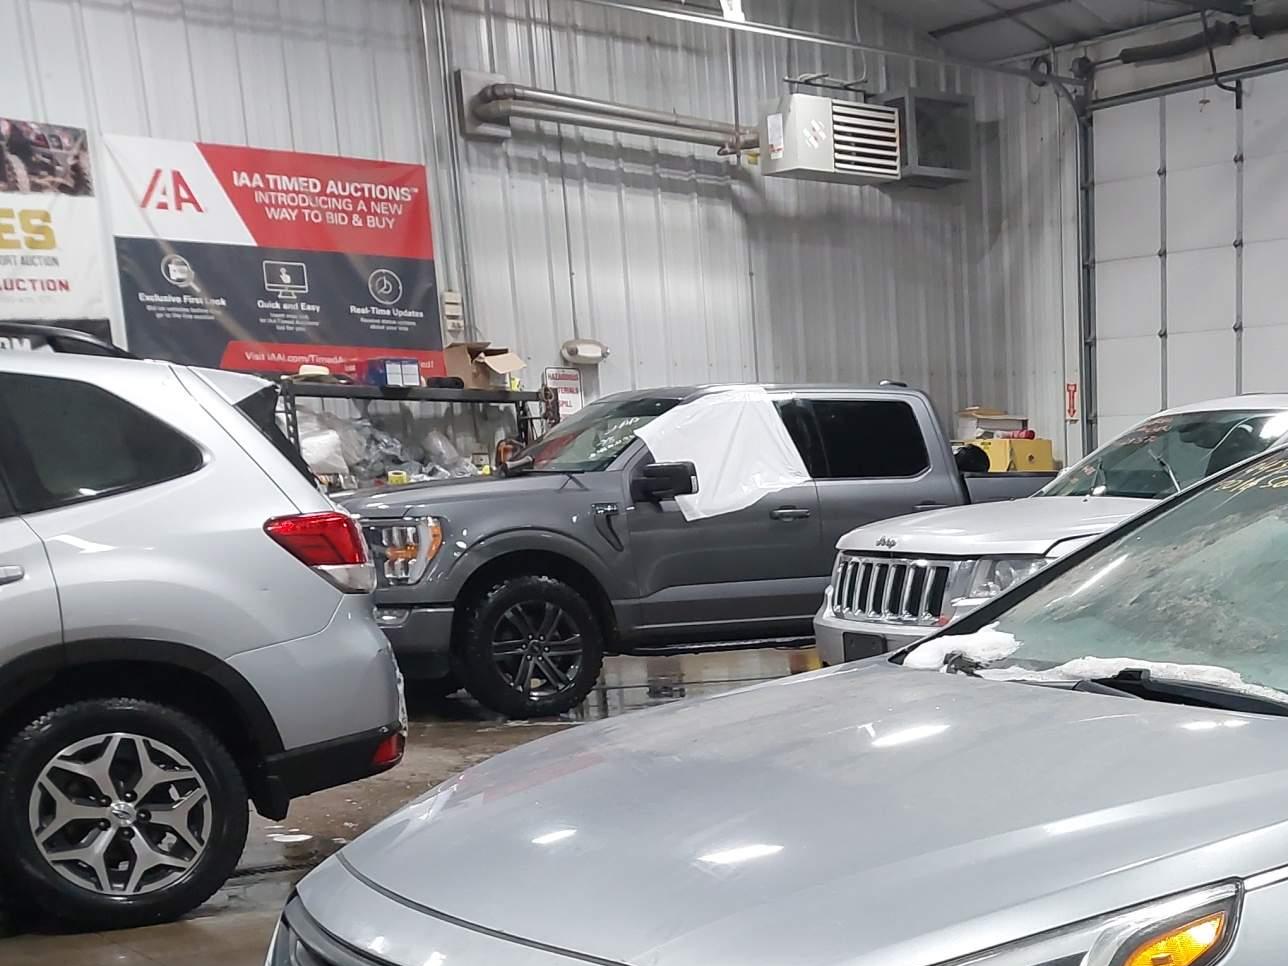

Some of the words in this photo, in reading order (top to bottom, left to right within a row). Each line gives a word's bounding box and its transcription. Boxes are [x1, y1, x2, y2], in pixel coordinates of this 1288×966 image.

[232, 170, 264, 187] IAA
[265, 174, 321, 193] TIMED
[254, 190, 353, 211] INTRODUCING
[356, 200, 368, 212] A
[370, 201, 403, 215] NEW
[265, 207, 299, 221] WAY
[302, 209, 322, 223] TO
[326, 213, 348, 225] BID
[351, 213, 363, 227] &
[367, 216, 395, 229] BUY
[257, 299, 281, 309] Quick
[282, 302, 299, 310] and
[300, 302, 321, 313] Easy
[349, 304, 391, 316] Real-Time
[392, 308, 424, 318] Updates
[244, 351, 265, 361] Visit
